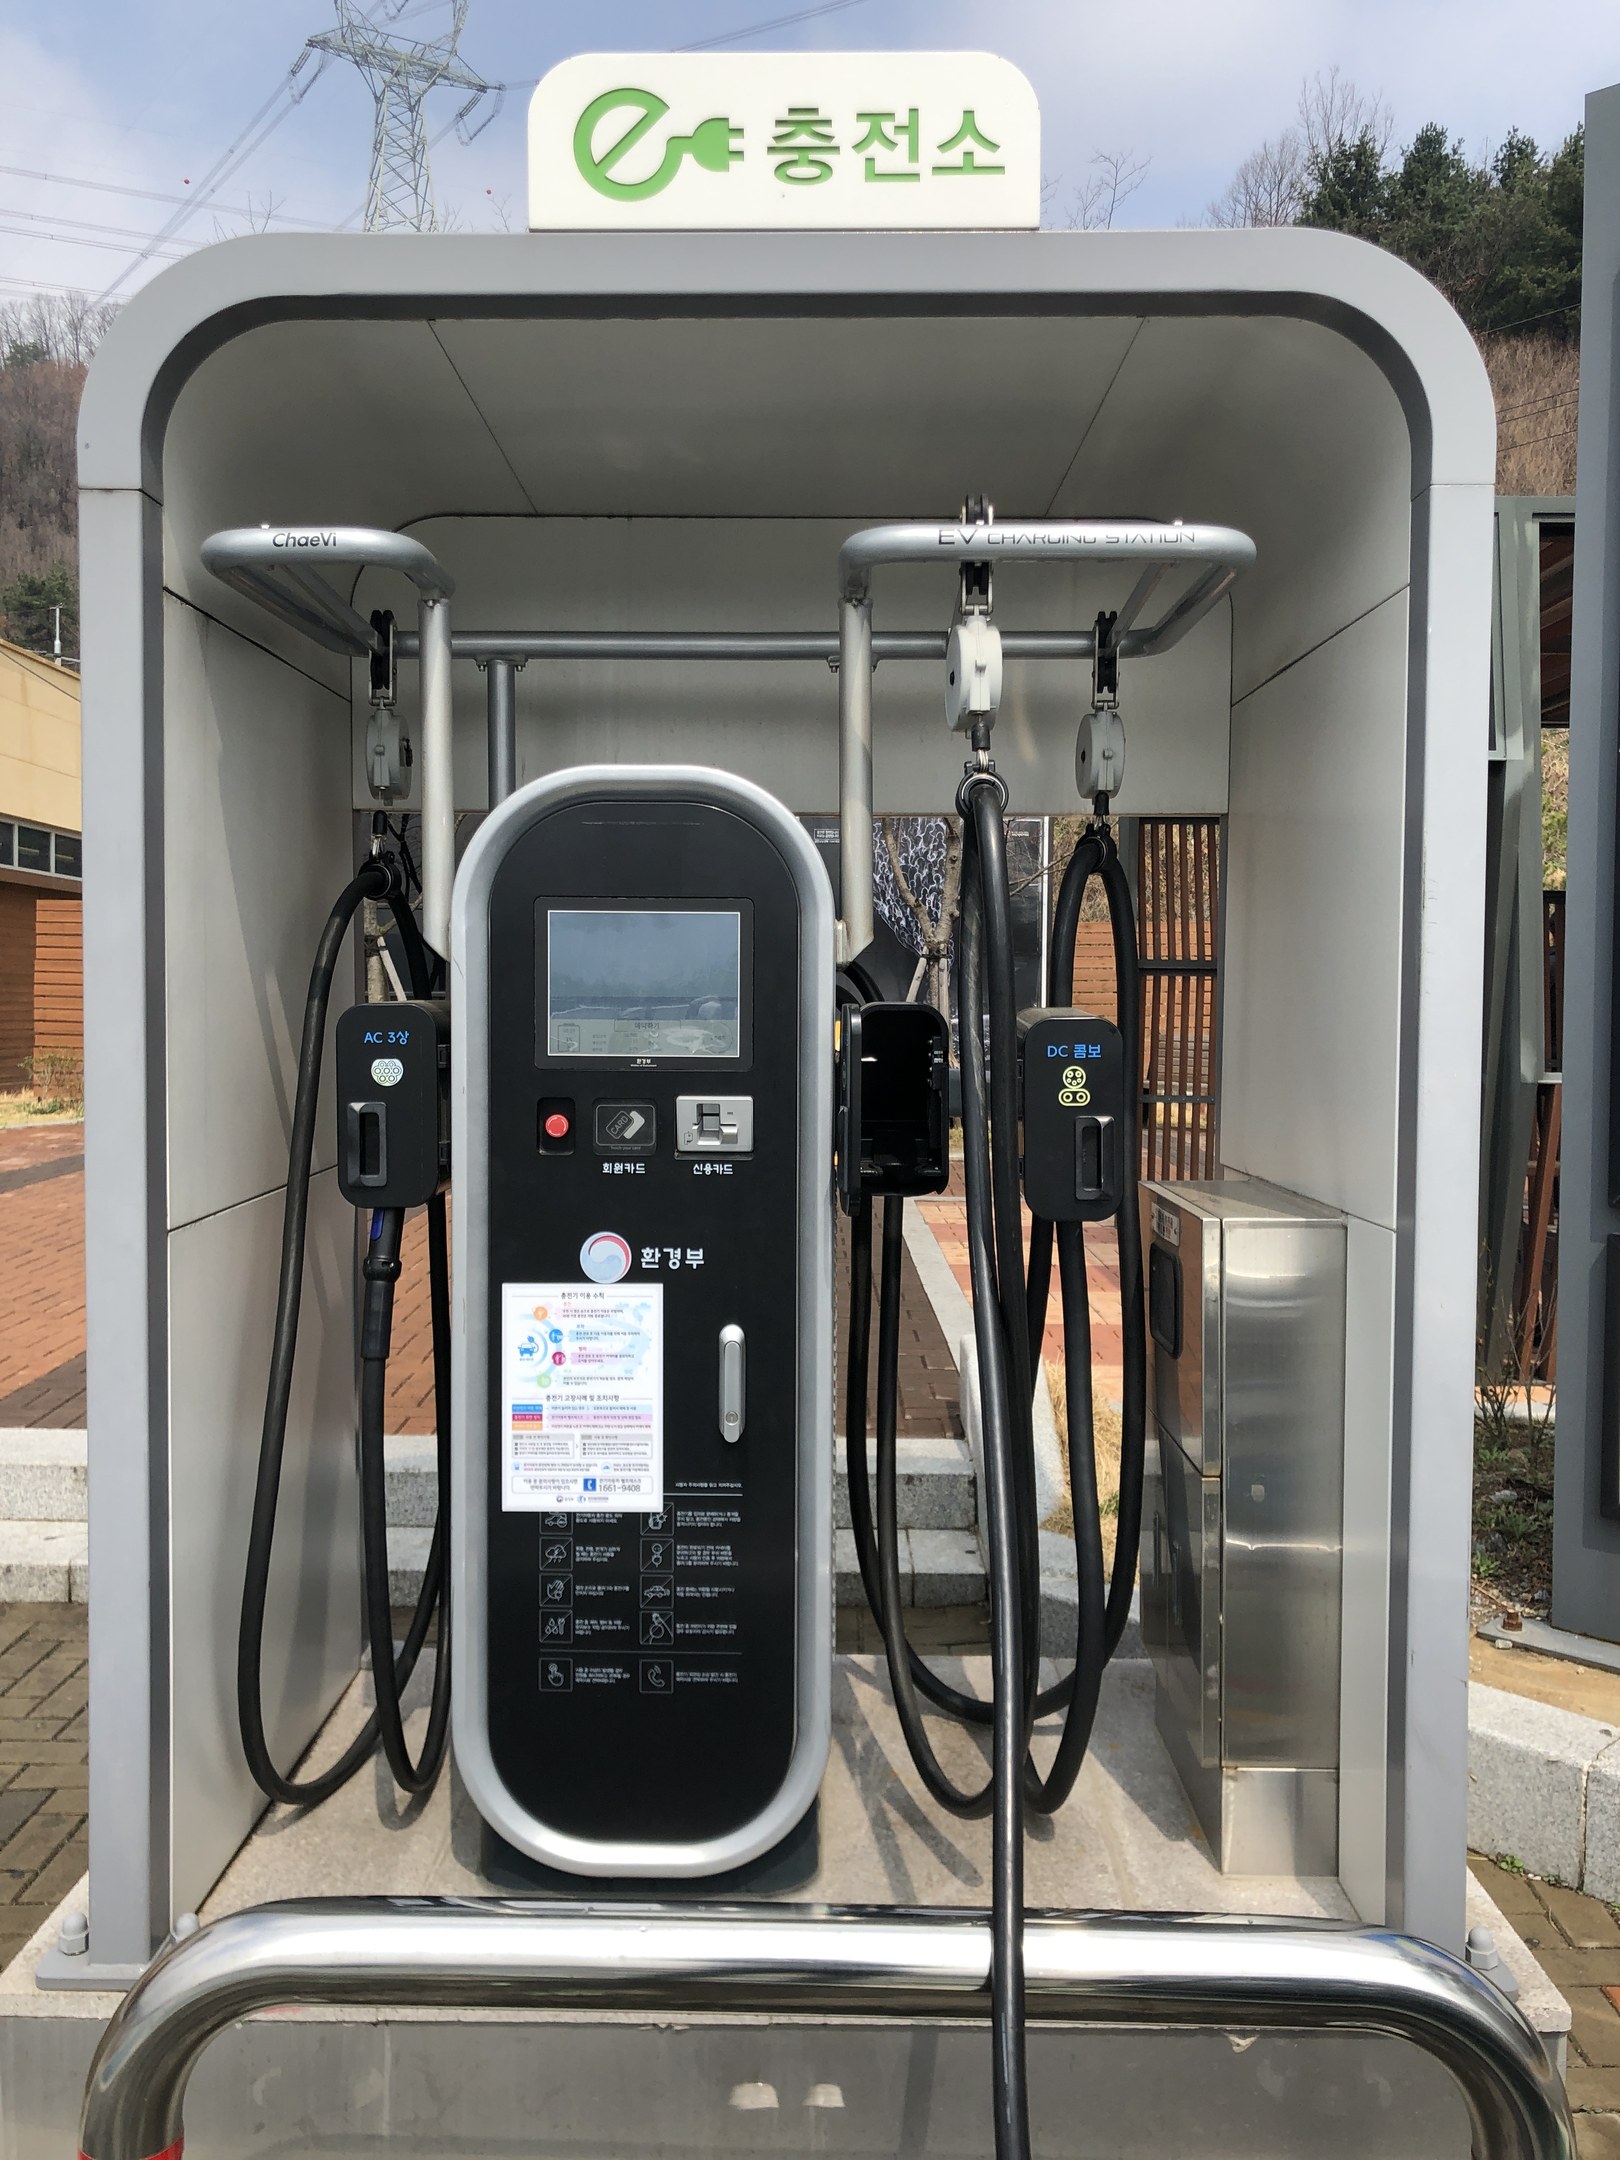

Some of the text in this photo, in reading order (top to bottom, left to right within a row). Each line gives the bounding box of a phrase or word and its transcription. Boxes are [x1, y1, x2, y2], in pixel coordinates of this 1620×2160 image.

[767, 107, 1006, 187] 충전소
[272, 532, 337, 547] ChaeVi
[938, 529, 978, 545] EV
[364, 1031, 410, 1045] AC 3상
[1047, 1044, 1102, 1059] DC 콤보
[610, 1115, 629, 1135] CARD
[602, 1162, 646, 1175] 회원카드
[693, 1162, 734, 1176] 신용카드
[640, 1247, 705, 1270] 환경부
[545, 1394, 563, 1402] 충전기
[564, 1394, 588, 1402] 고장사례
[596, 1394, 620, 1402] 조치사항
